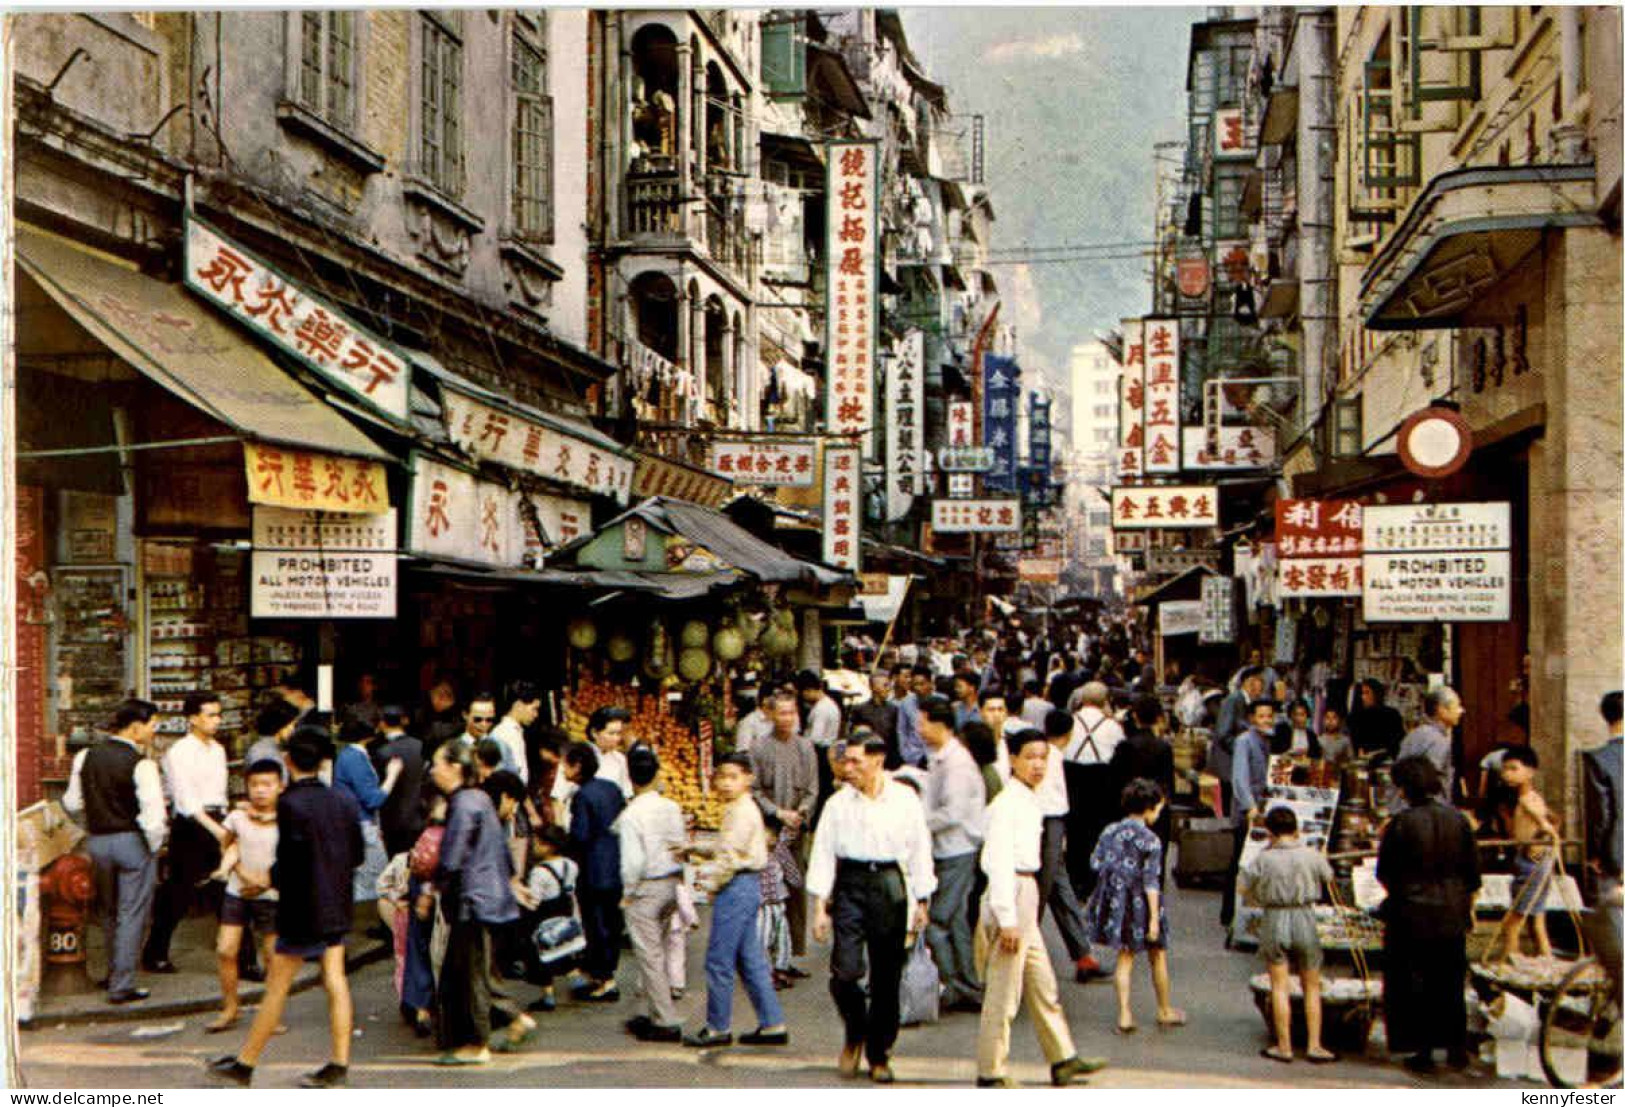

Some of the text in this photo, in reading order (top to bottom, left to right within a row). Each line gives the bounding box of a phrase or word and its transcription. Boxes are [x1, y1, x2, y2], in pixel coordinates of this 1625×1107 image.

[278, 558, 373, 573] PROHIBITED
[1388, 558, 1486, 573] PROHIBITED
[259, 575, 282, 587] ALL
[336, 576, 390, 587] VEHICLES
[1370, 576, 1504, 590] ALL MOTOR VEHICLES
